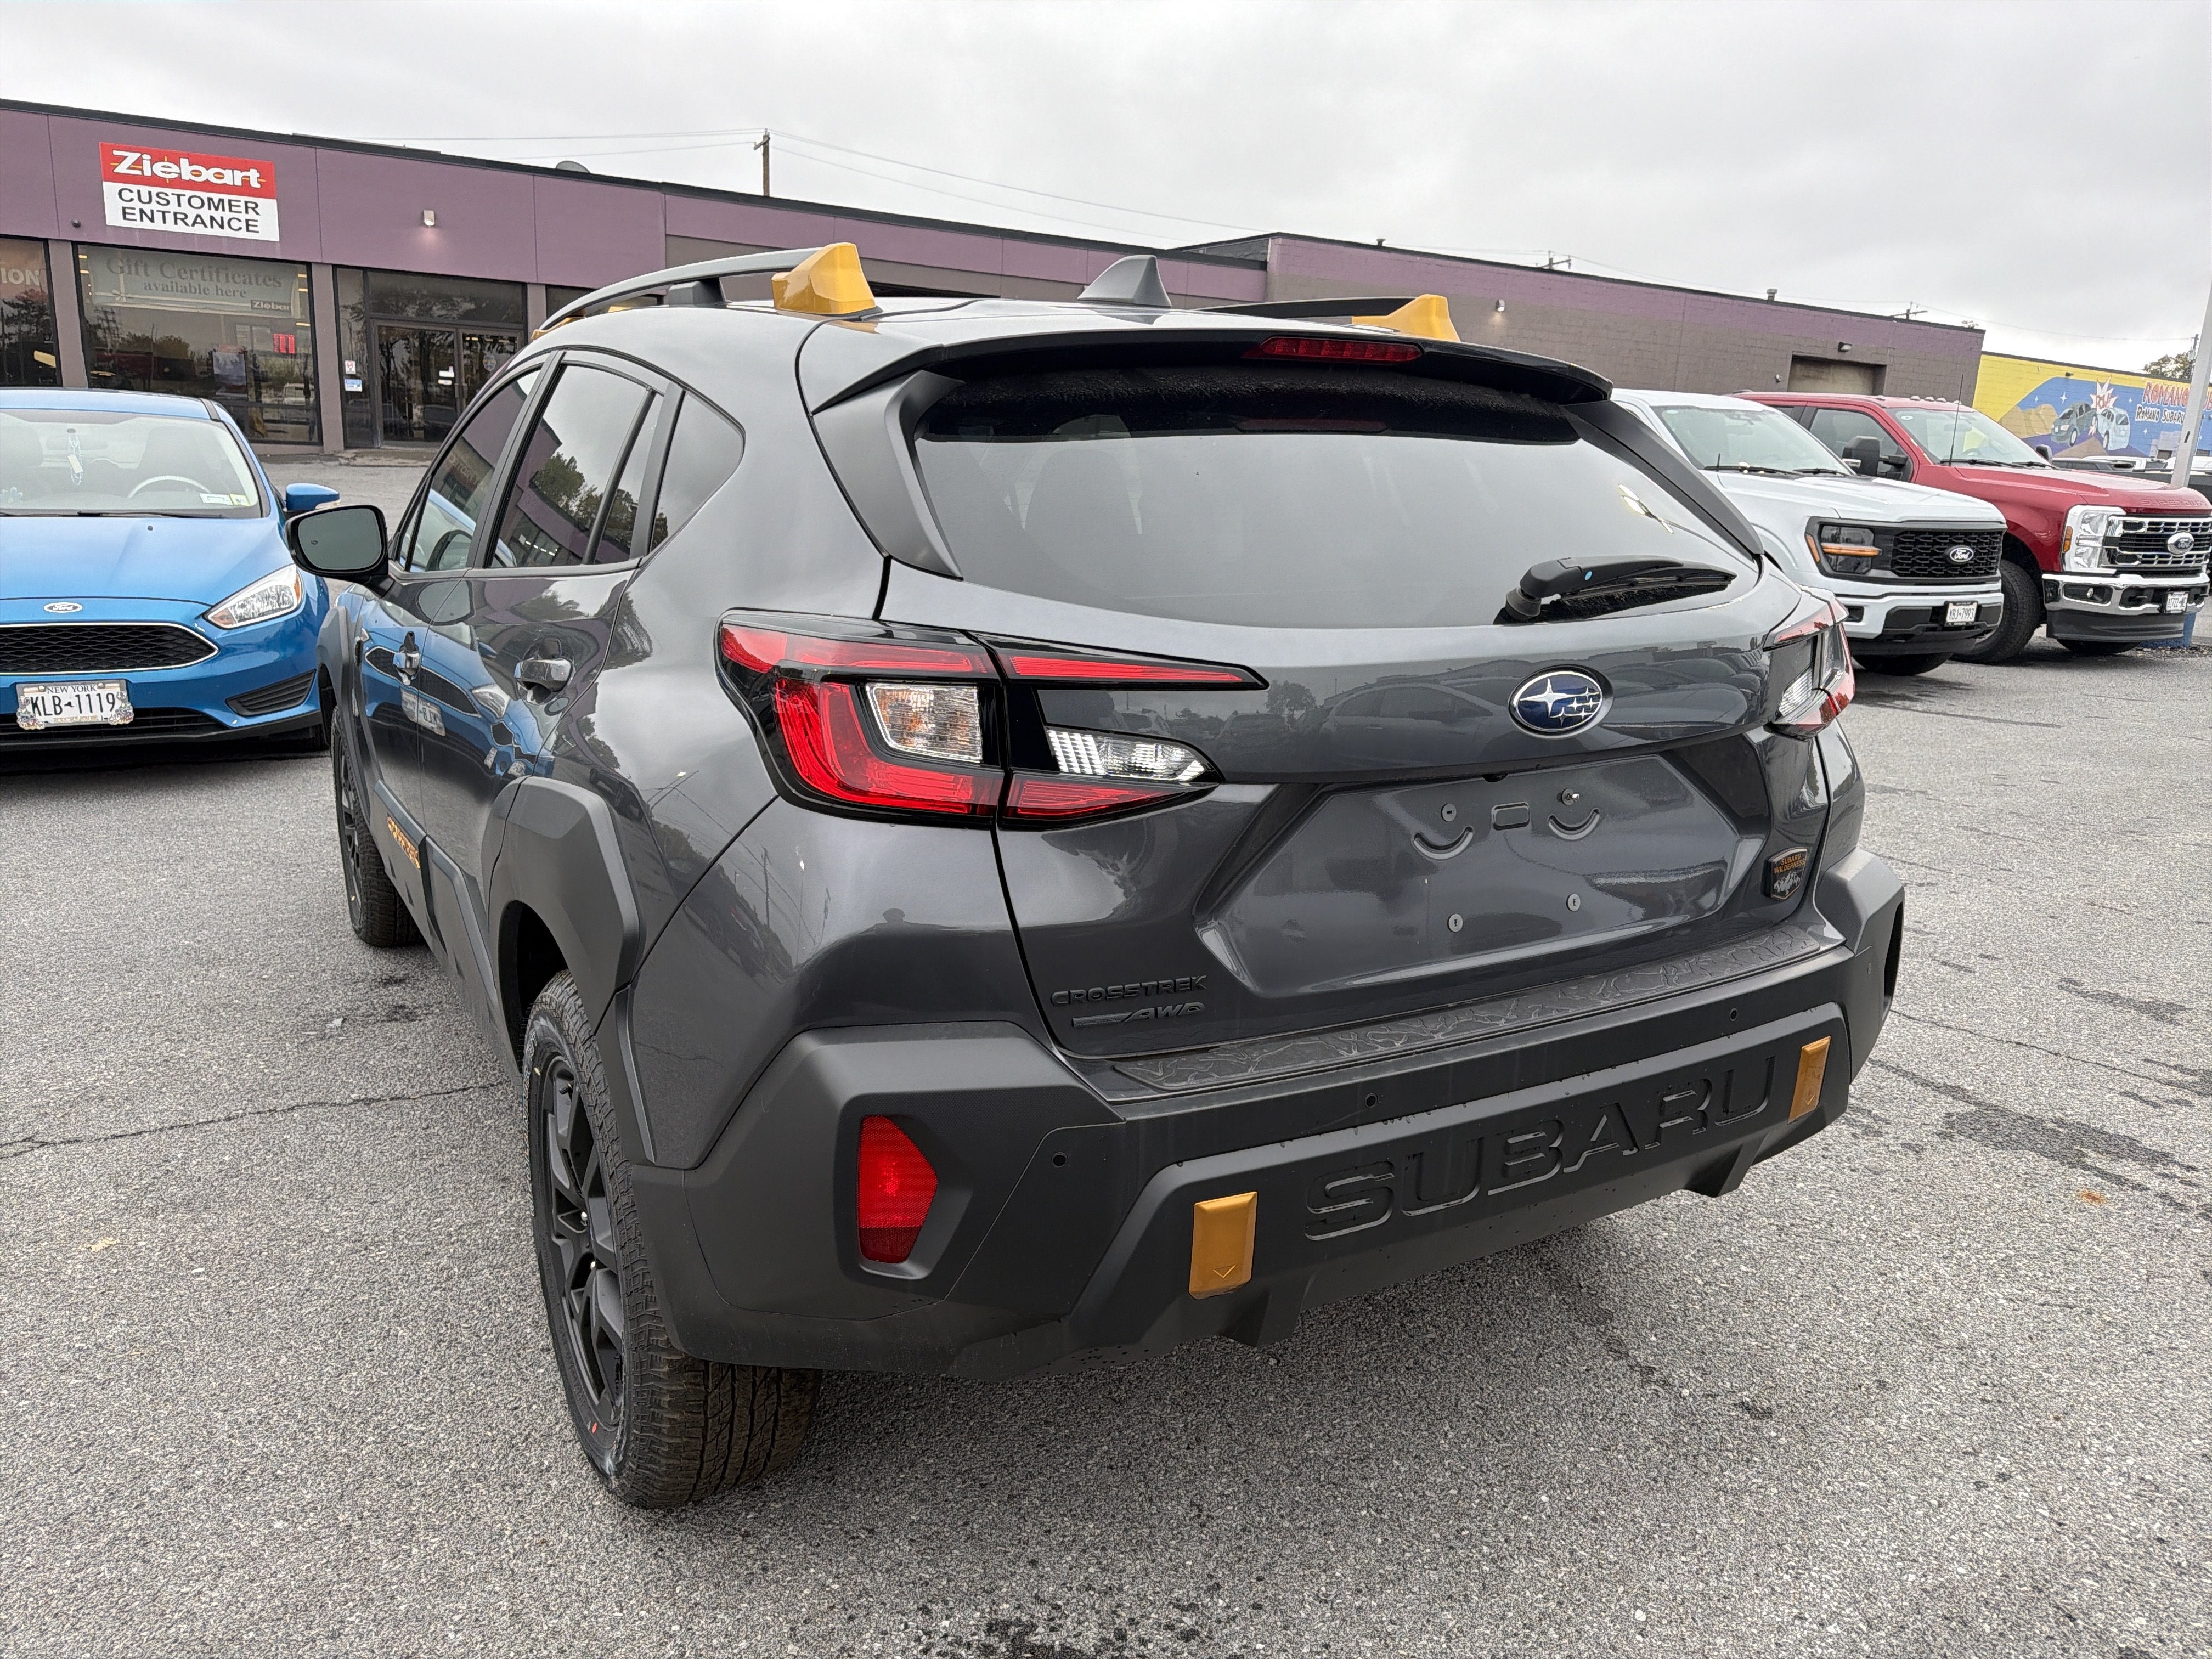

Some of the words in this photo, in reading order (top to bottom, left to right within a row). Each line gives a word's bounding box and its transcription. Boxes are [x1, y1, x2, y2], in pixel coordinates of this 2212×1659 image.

[111, 149, 262, 188] Ziebart
[117, 188, 261, 216] CUSTOMER
[121, 206, 260, 234] ENTRANCE
[106, 256, 150, 278] Gift
[159, 262, 283, 289] Certificates
[144, 280, 210, 296] available
[215, 285, 247, 298] here
[252, 301, 291, 311] Ziebar
[2142, 382, 2190, 407] ROMANO
[1954, 549, 1970, 560] Ford
[47, 686, 69, 695] NEW
[71, 684, 97, 693] YORK
[30, 695, 63, 716] KLB
[75, 692, 115, 714] 1119
[1773, 858, 1806, 874] WILDERNESS
[1781, 853, 1802, 865] SUBARU
[1051, 975, 1207, 1007] CROSSTREK
[1123, 1001, 1206, 1023] AWD
[1304, 1056, 1776, 1242] SUBARU
